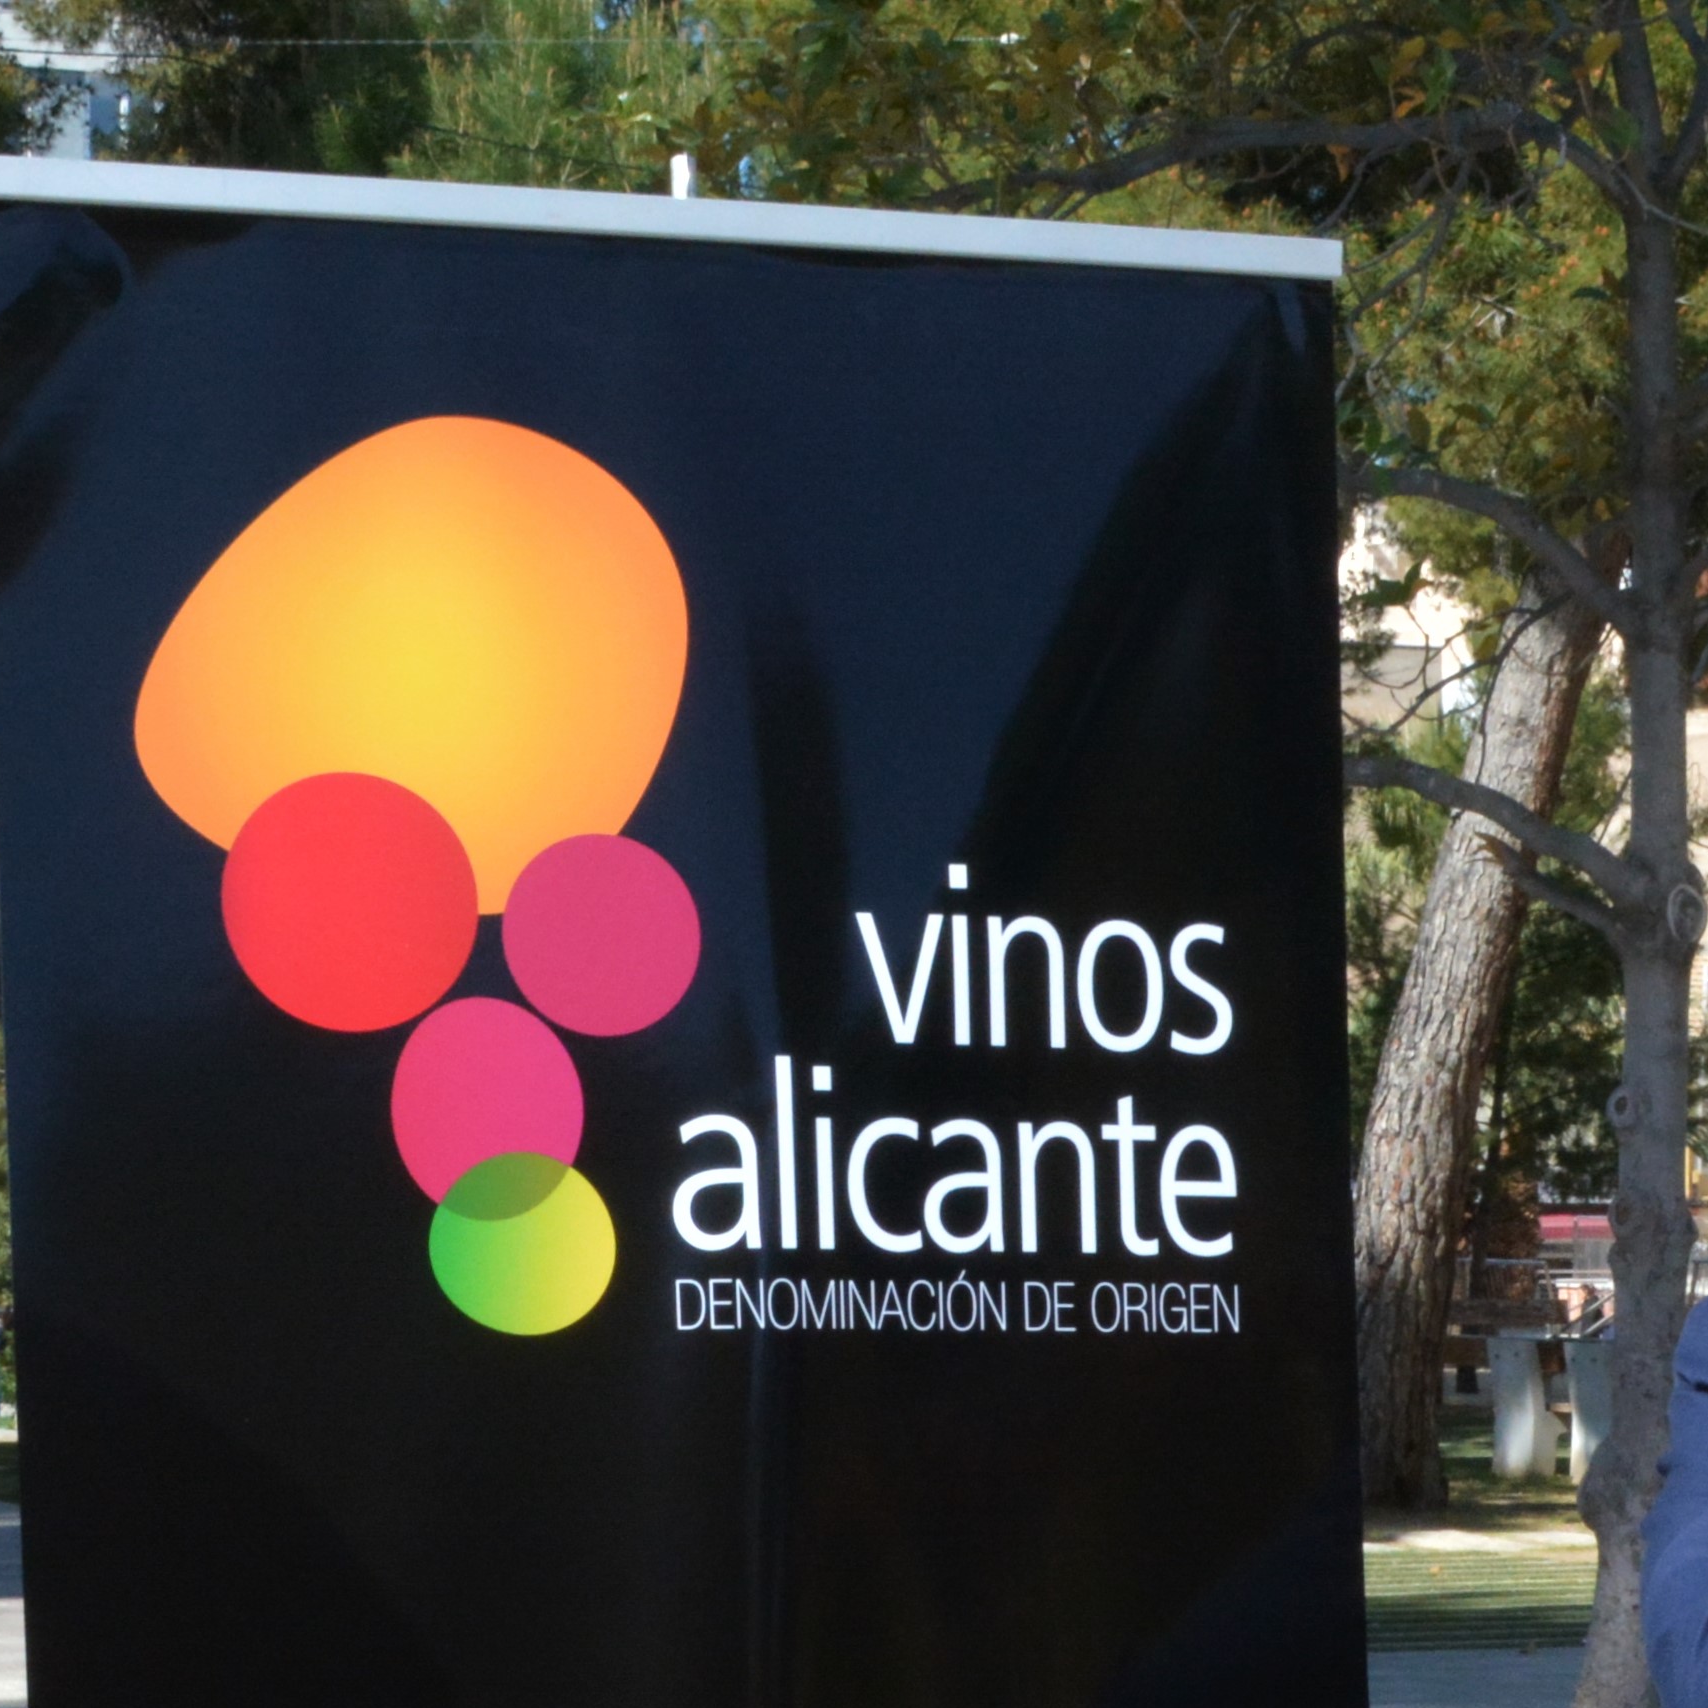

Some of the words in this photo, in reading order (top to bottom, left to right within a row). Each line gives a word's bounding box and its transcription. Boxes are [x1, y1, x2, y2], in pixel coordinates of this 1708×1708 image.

[855, 863, 1233, 1056] vinos
[671, 1054, 1238, 1258] alicante
[674, 1269, 1007, 1332] DENOMINACIÓN
[1023, 1281, 1077, 1332] DE
[1091, 1281, 1240, 1334] ORIGEN
